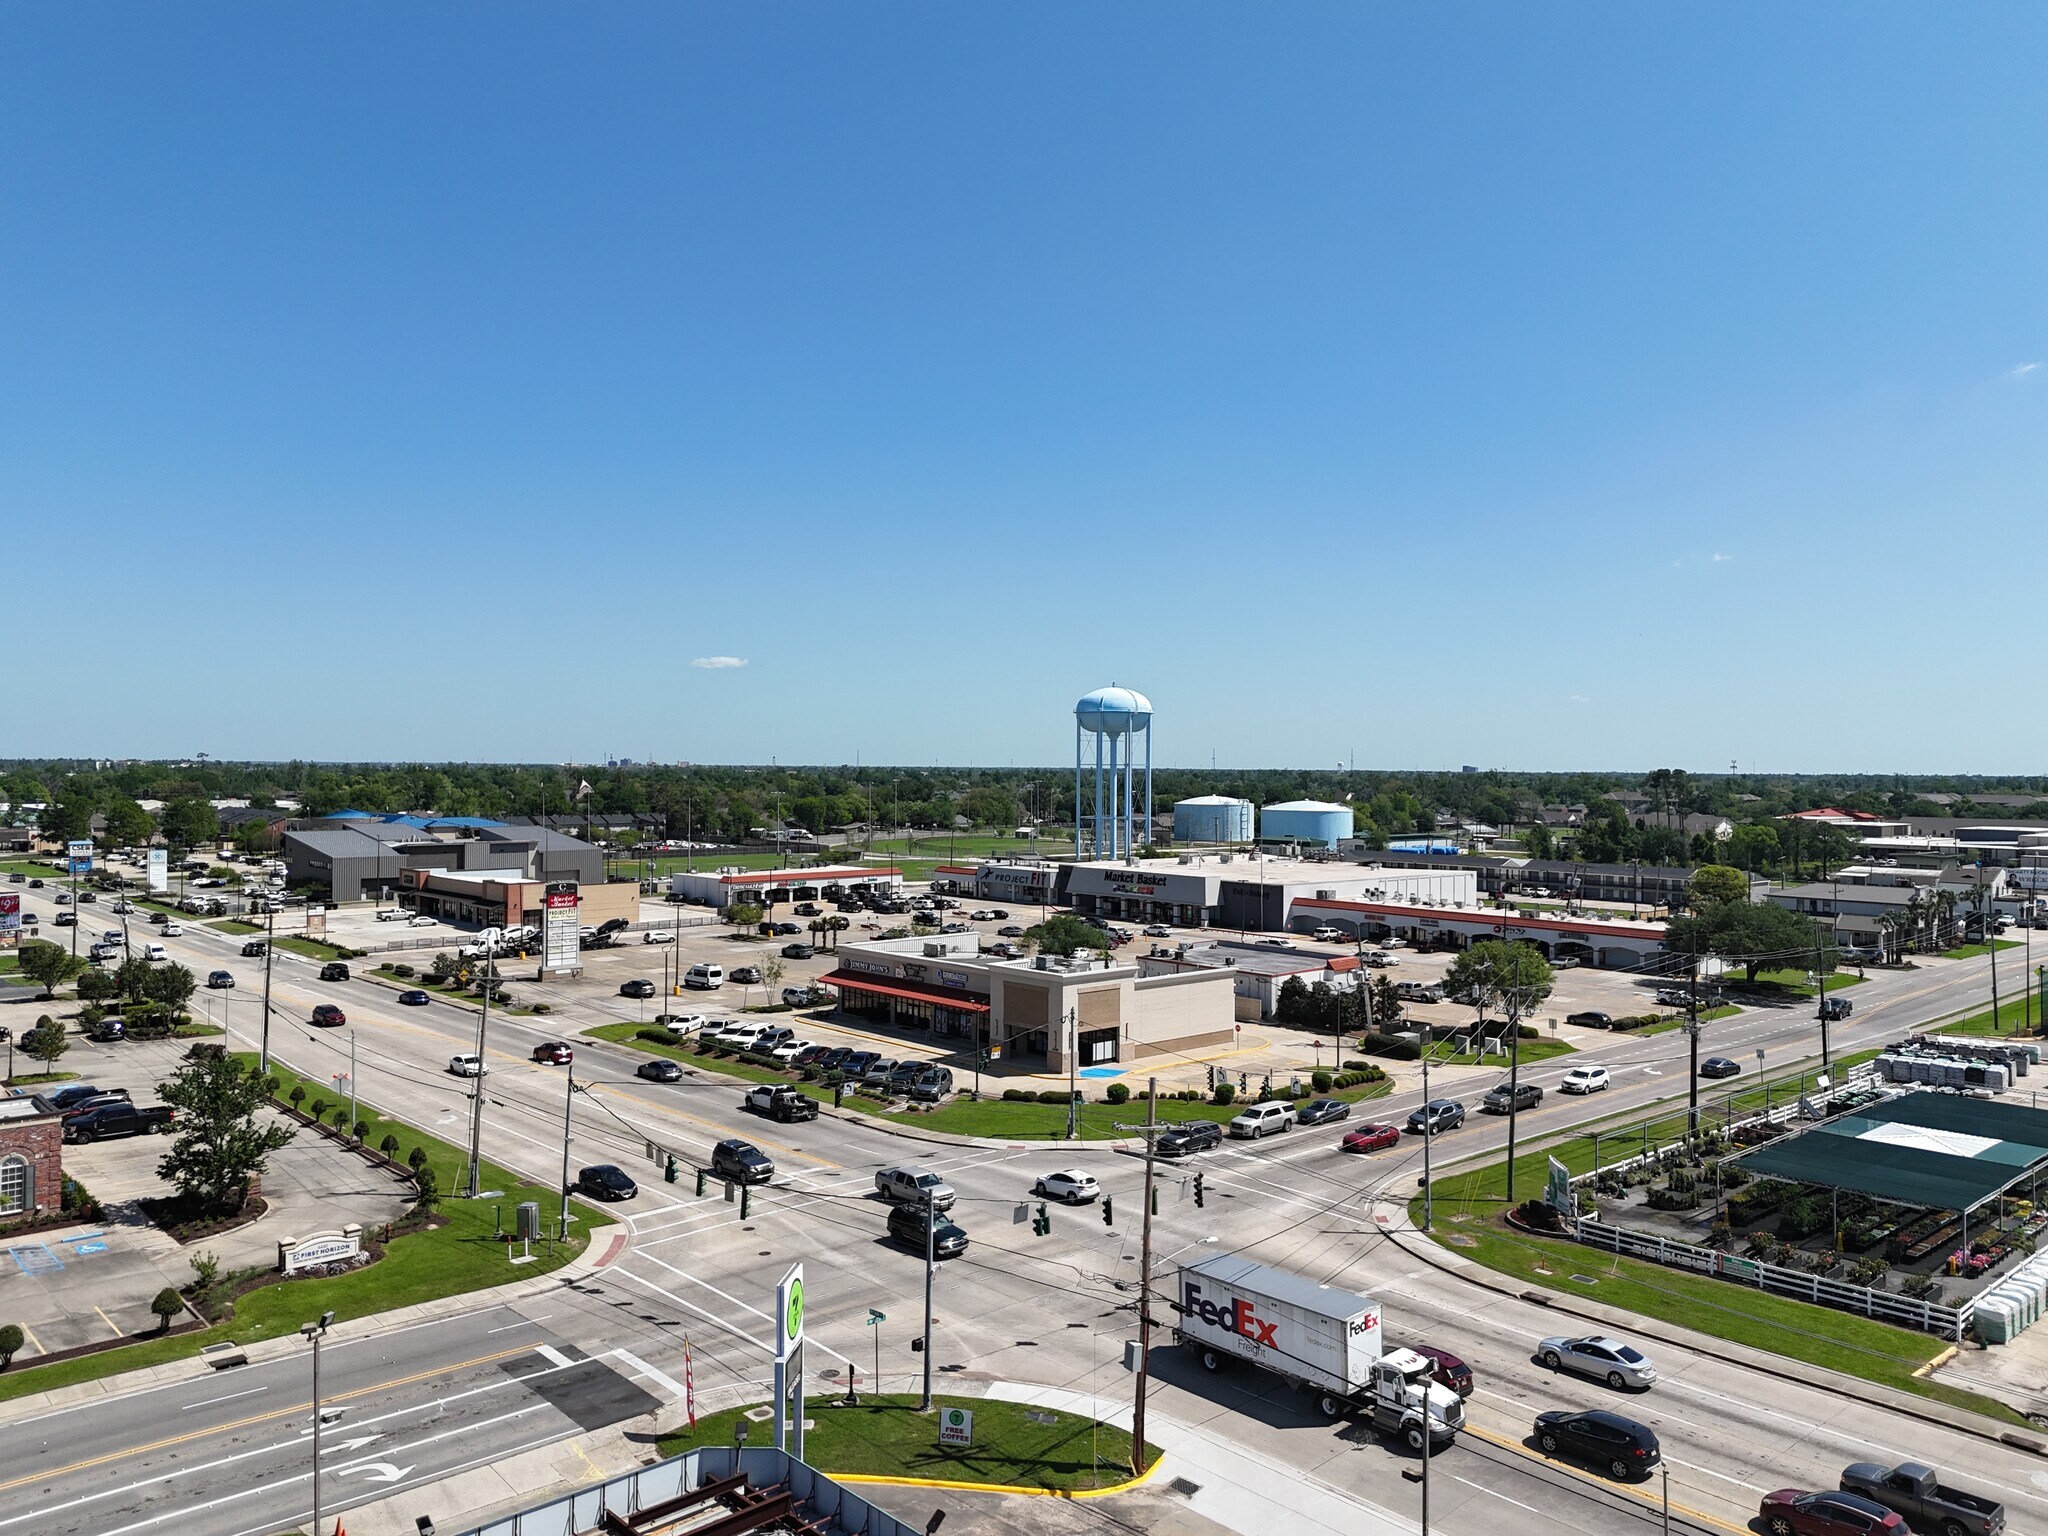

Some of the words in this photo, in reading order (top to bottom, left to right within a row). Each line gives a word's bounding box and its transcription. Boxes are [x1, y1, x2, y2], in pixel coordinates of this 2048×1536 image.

[995, 873, 1029, 884] PROJECT
[1031, 872, 1047, 886] FIT
[1104, 871, 1134, 883] Market
[1137, 874, 1167, 886] Basket
[851, 960, 868, 970] JIMMY
[301, 1250, 319, 1258] FIRST
[320, 1244, 350, 1254] HORIZON
[1185, 1281, 1279, 1350] FedEx
[1349, 1313, 1379, 1338] FedEx
[1237, 1338, 1266, 1358] Freight
[941, 1433, 969, 1442] COFFEE
[945, 1427, 964, 1435] FREE
